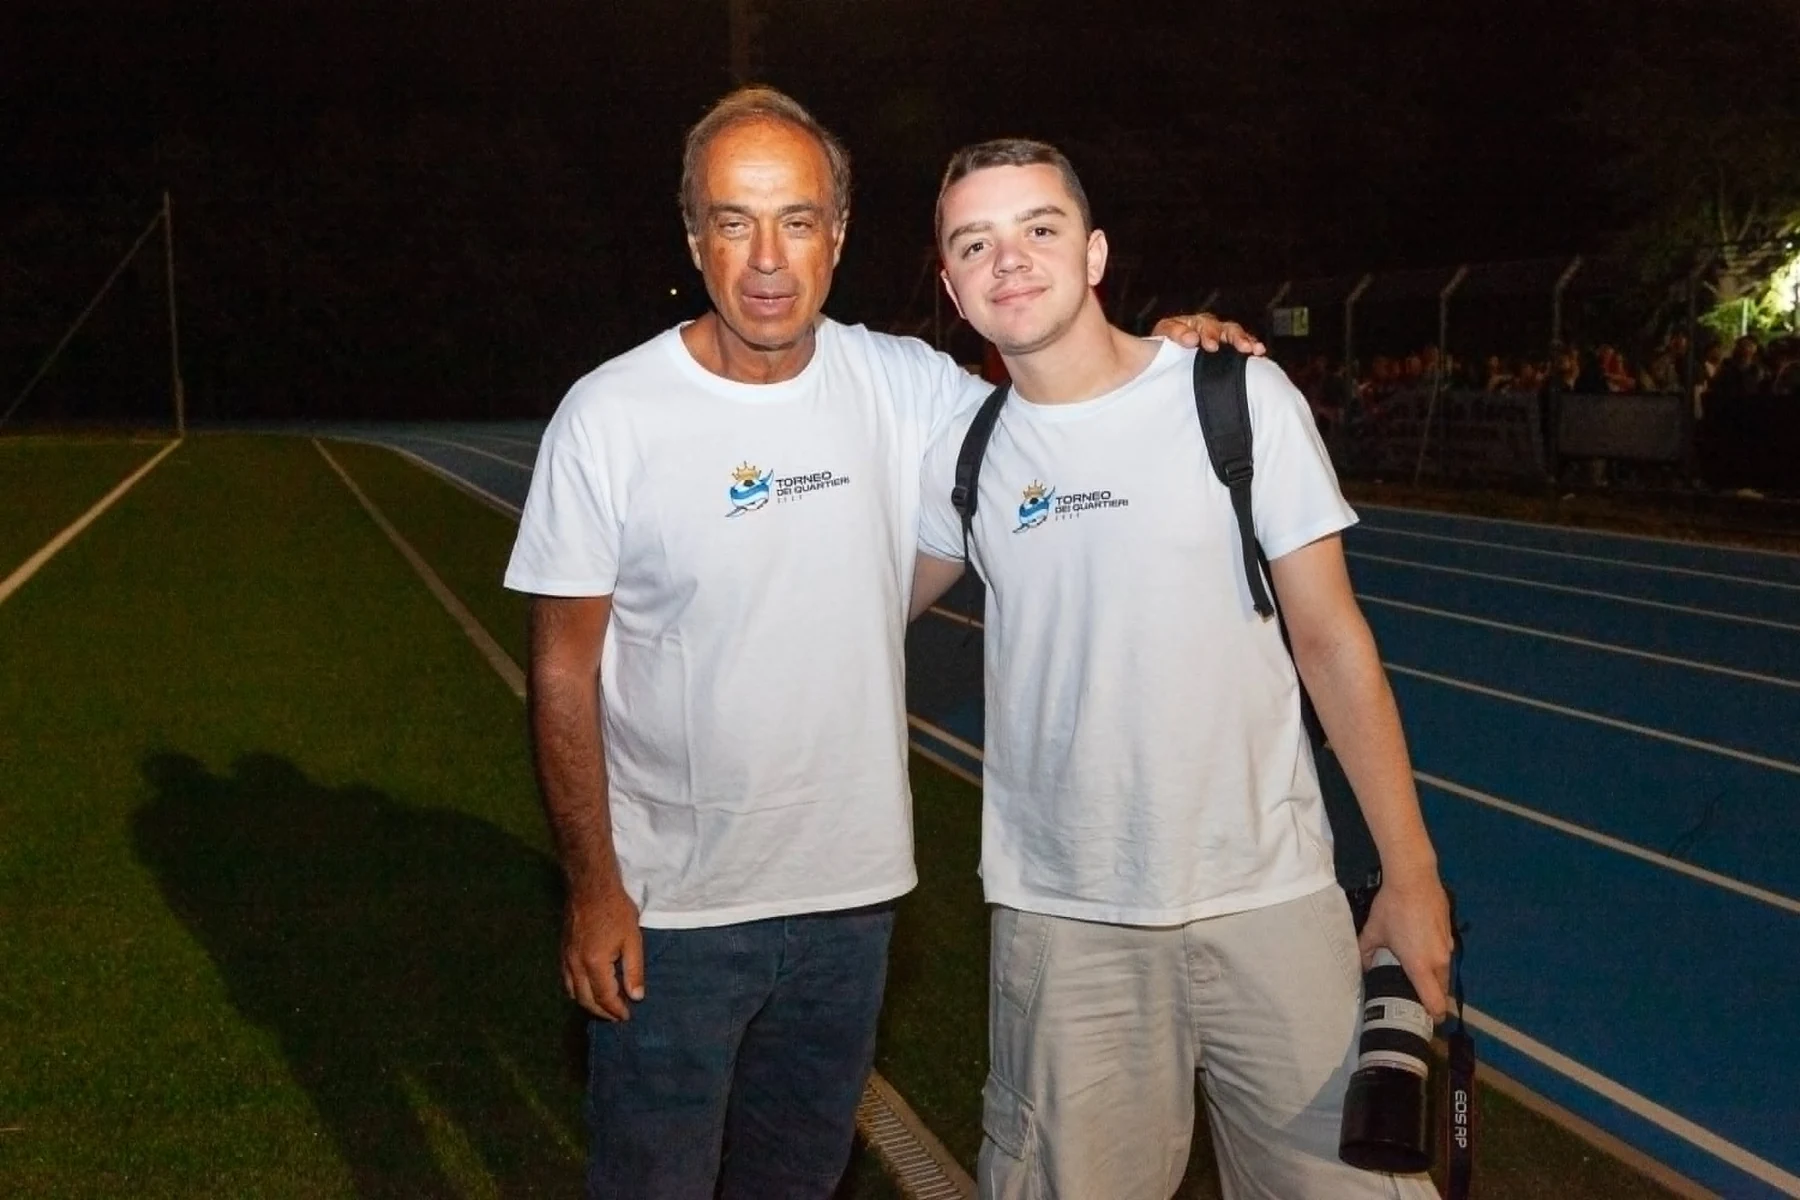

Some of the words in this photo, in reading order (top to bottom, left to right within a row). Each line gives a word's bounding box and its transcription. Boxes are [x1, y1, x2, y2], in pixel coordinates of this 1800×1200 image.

[775, 471, 832, 488] TORNEO
[776, 488, 792, 497] DEI
[794, 477, 850, 494] QUARTIERI
[1055, 490, 1112, 505] TORNEO
[1055, 505, 1071, 513] DEI
[1072, 499, 1129, 512] QUARTIERI
[1454, 1089, 1467, 1125] EOS
[1454, 1126, 1468, 1149] RP
